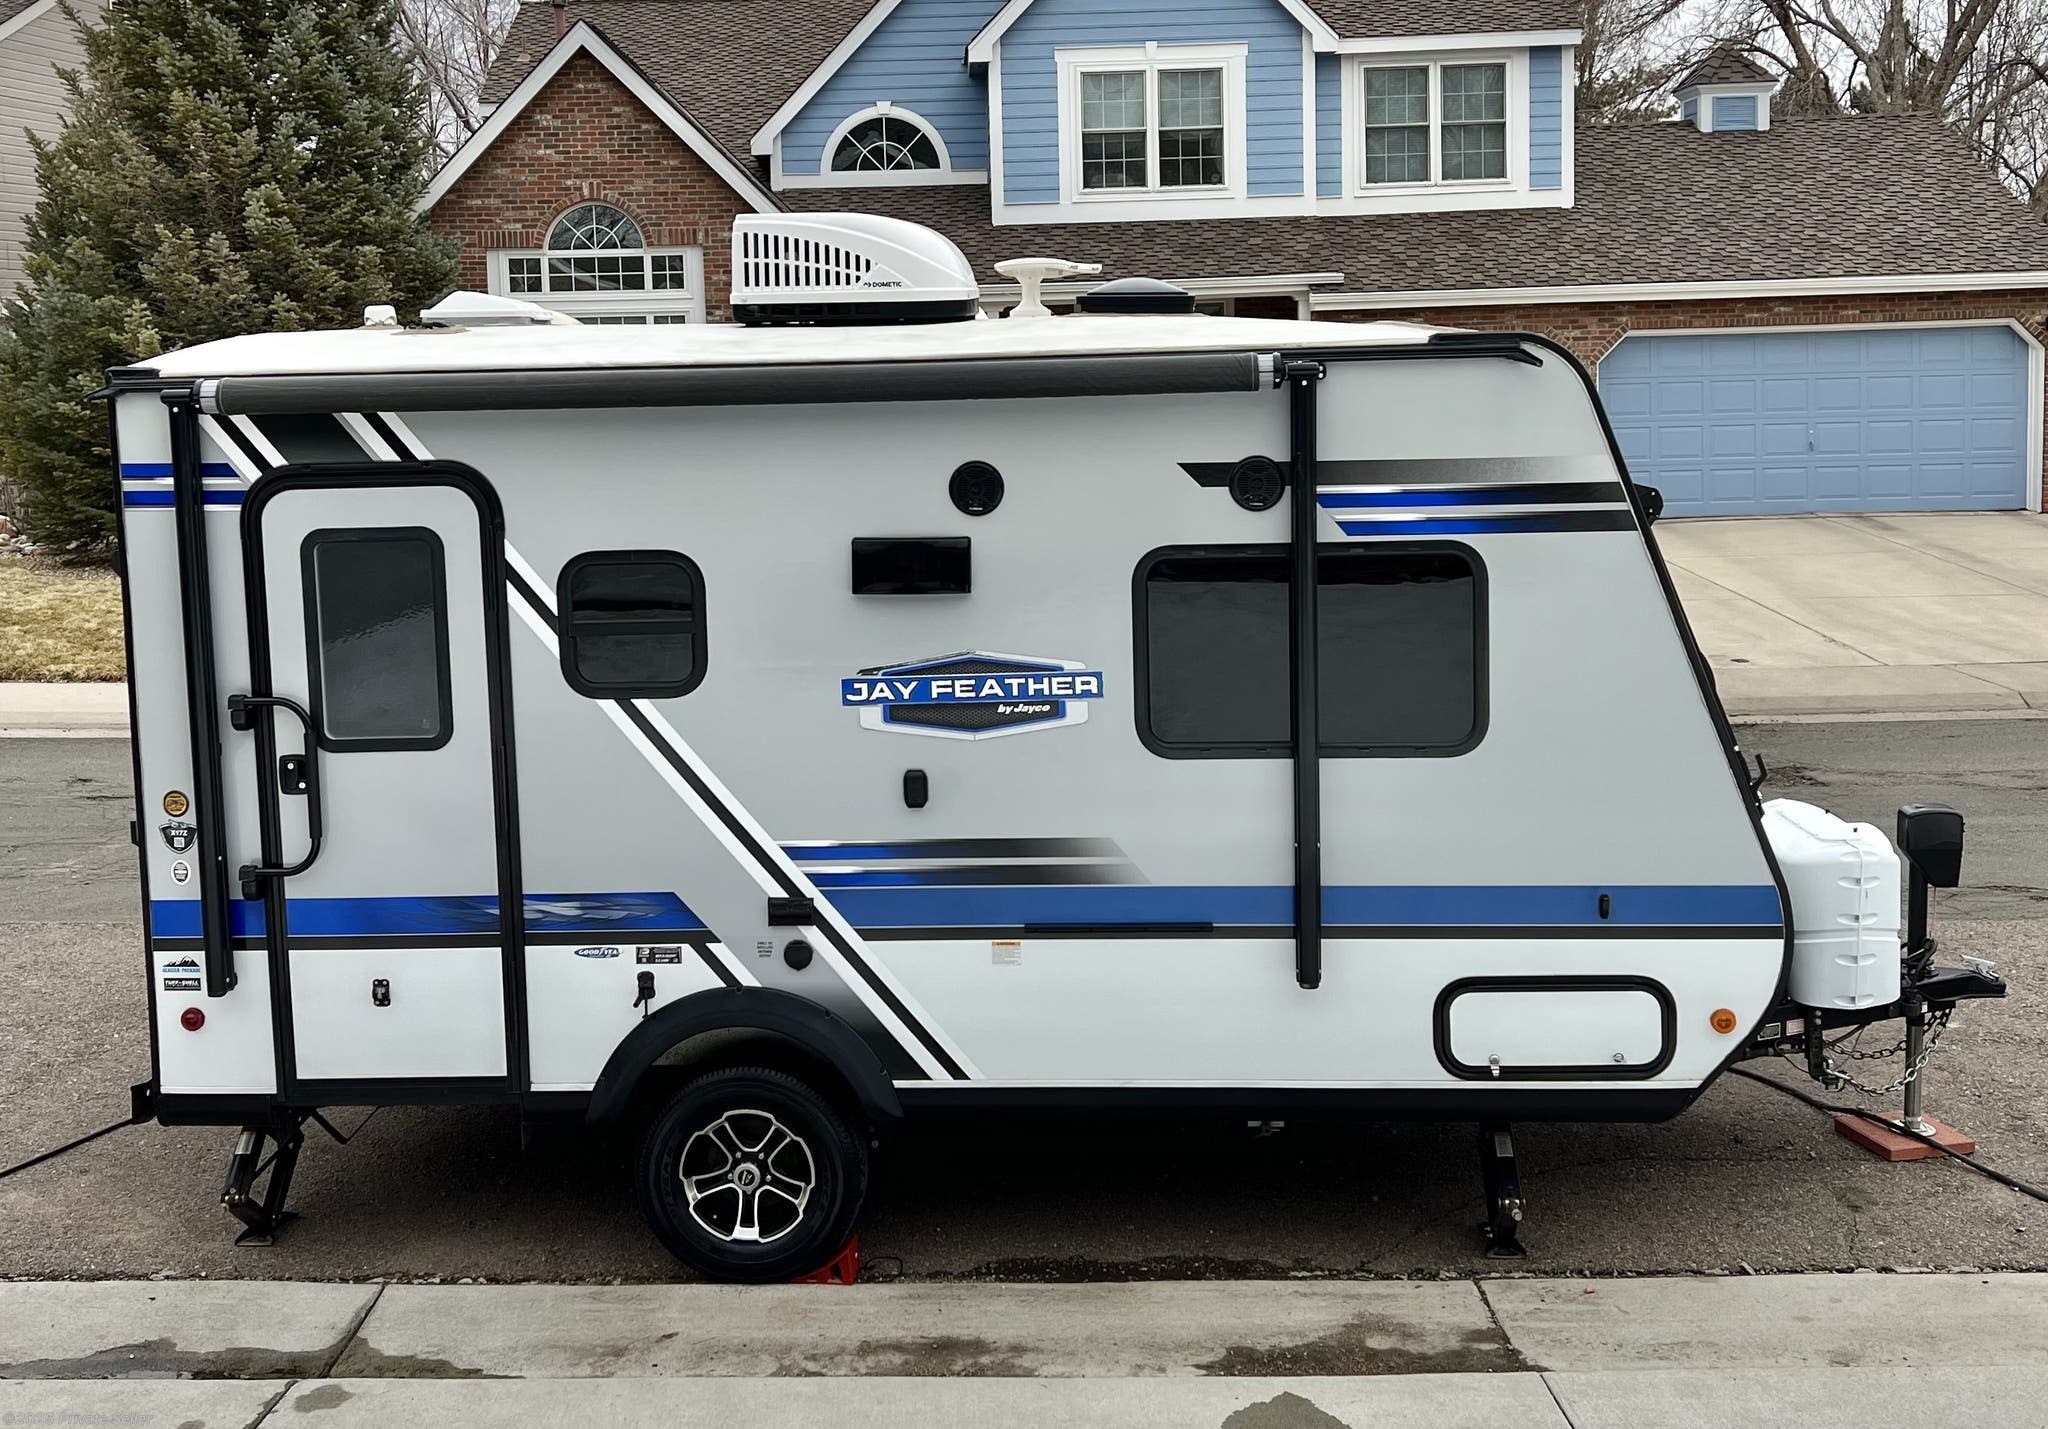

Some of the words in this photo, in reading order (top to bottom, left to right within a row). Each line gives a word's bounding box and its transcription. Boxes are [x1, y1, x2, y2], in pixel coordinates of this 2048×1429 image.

[845, 680, 920, 701] JAY
[930, 675, 1100, 700] FEATHER
[997, 704, 1013, 714] by
[1013, 703, 1051, 715] Jayco
